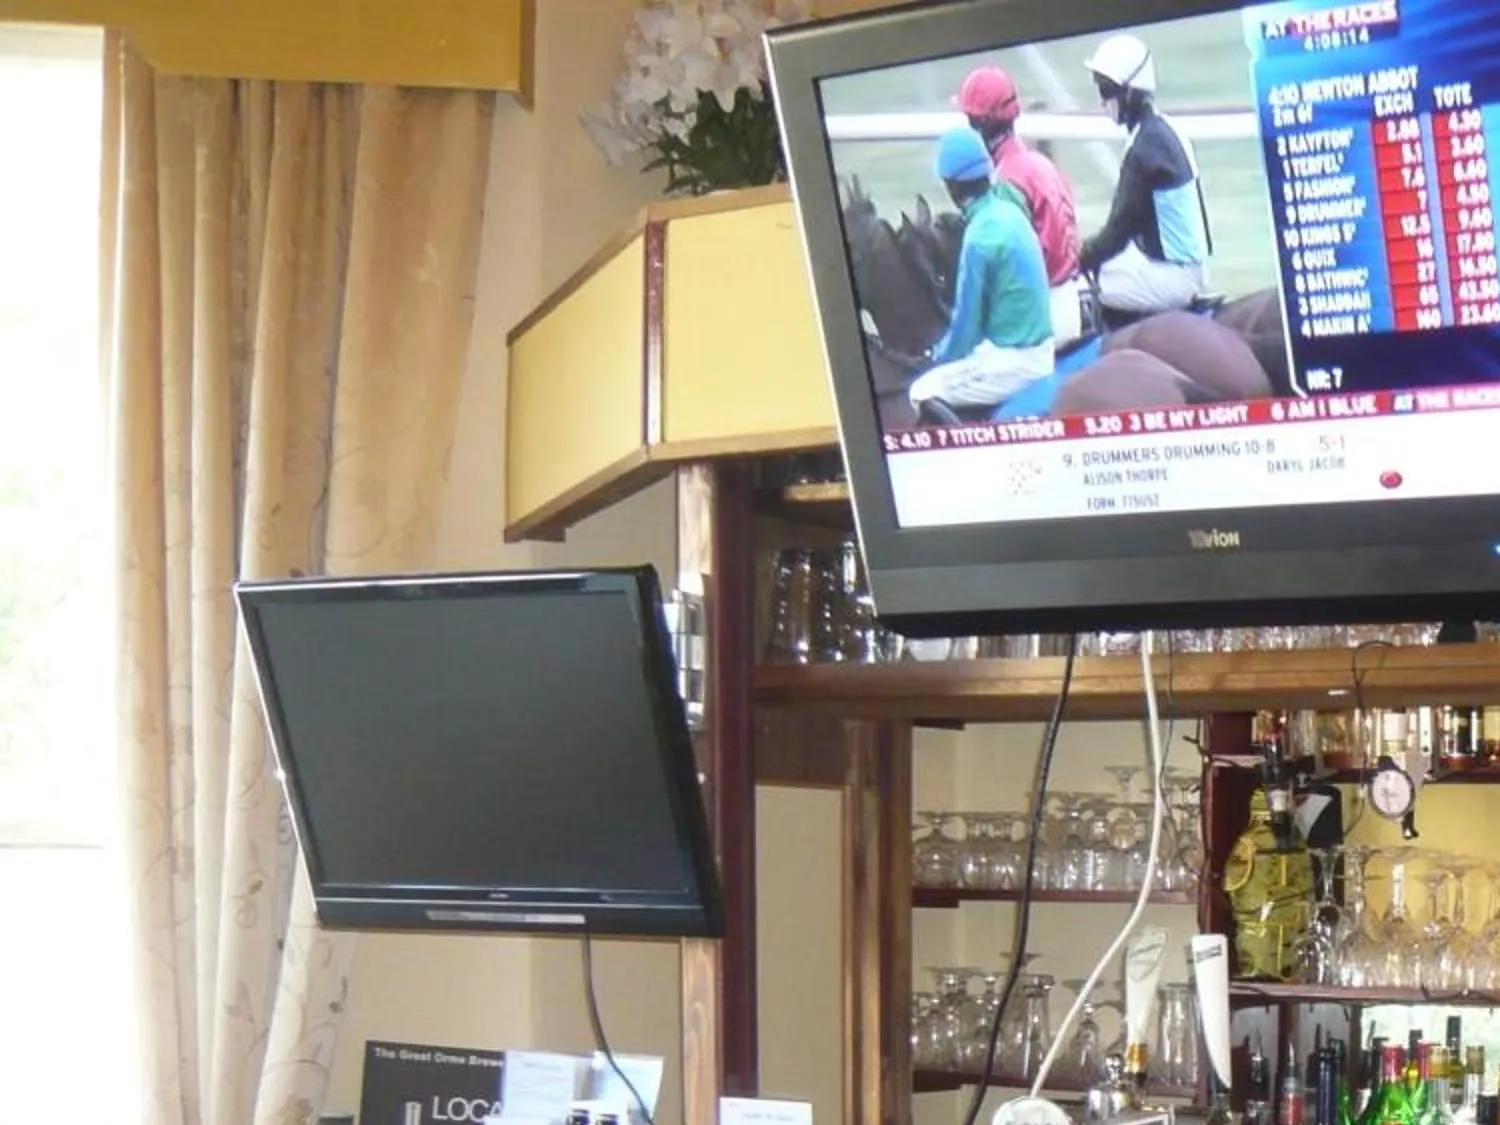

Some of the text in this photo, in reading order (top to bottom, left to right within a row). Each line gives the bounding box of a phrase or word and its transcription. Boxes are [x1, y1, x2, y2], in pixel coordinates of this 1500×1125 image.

[1301, 74, 1366, 102] NEWTON
[1368, 65, 1419, 94] ABBOT
[1374, 82, 1473, 116] EXCH TOTE
[950, 426, 996, 446] TITCH
[1169, 409, 1196, 429] MY
[1199, 404, 1249, 426] LIGHT
[1287, 400, 1316, 419] AM
[1083, 446, 1161, 468] DRUMMERS
[1165, 440, 1242, 461] DRUMMING
[399, 1049, 431, 1061] Great
[431, 1095, 503, 1123] LOCA
